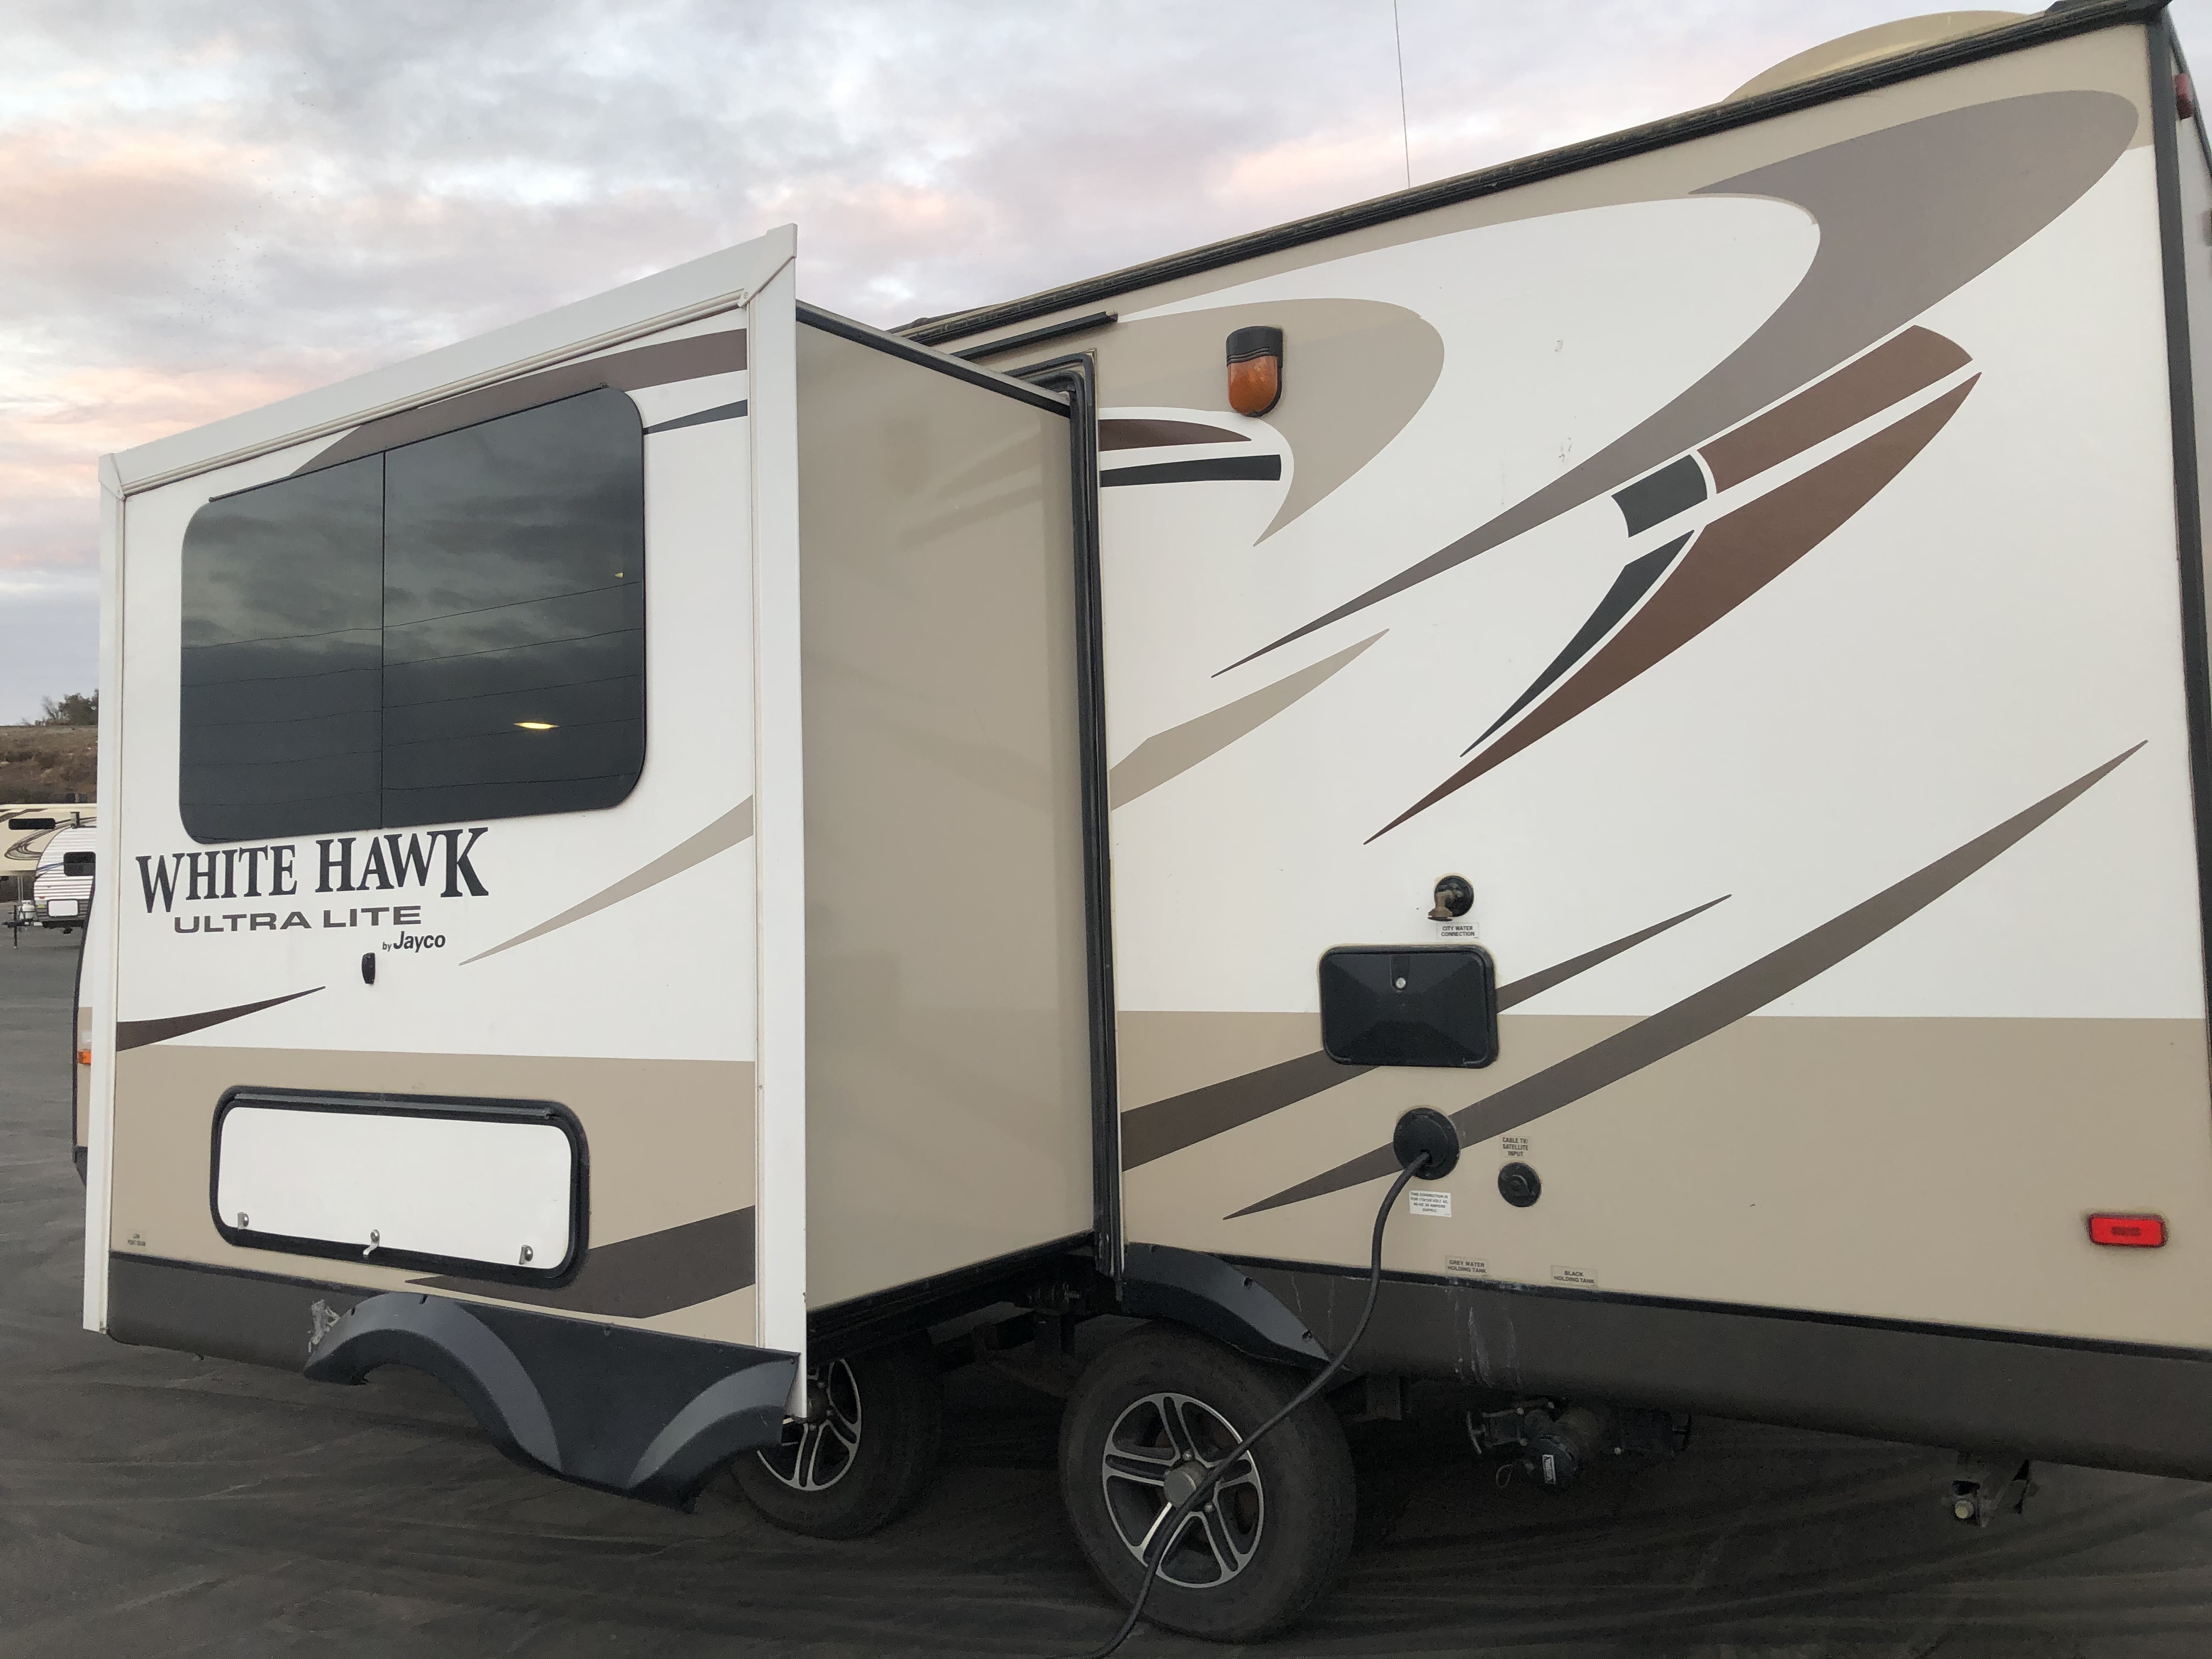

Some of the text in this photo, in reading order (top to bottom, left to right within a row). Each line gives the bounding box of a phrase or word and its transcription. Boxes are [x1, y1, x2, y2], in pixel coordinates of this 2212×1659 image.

[136, 827, 489, 913] WHITE HAWK
[174, 905, 422, 933] ULTRA LITE
[382, 930, 445, 953] by Jayco
